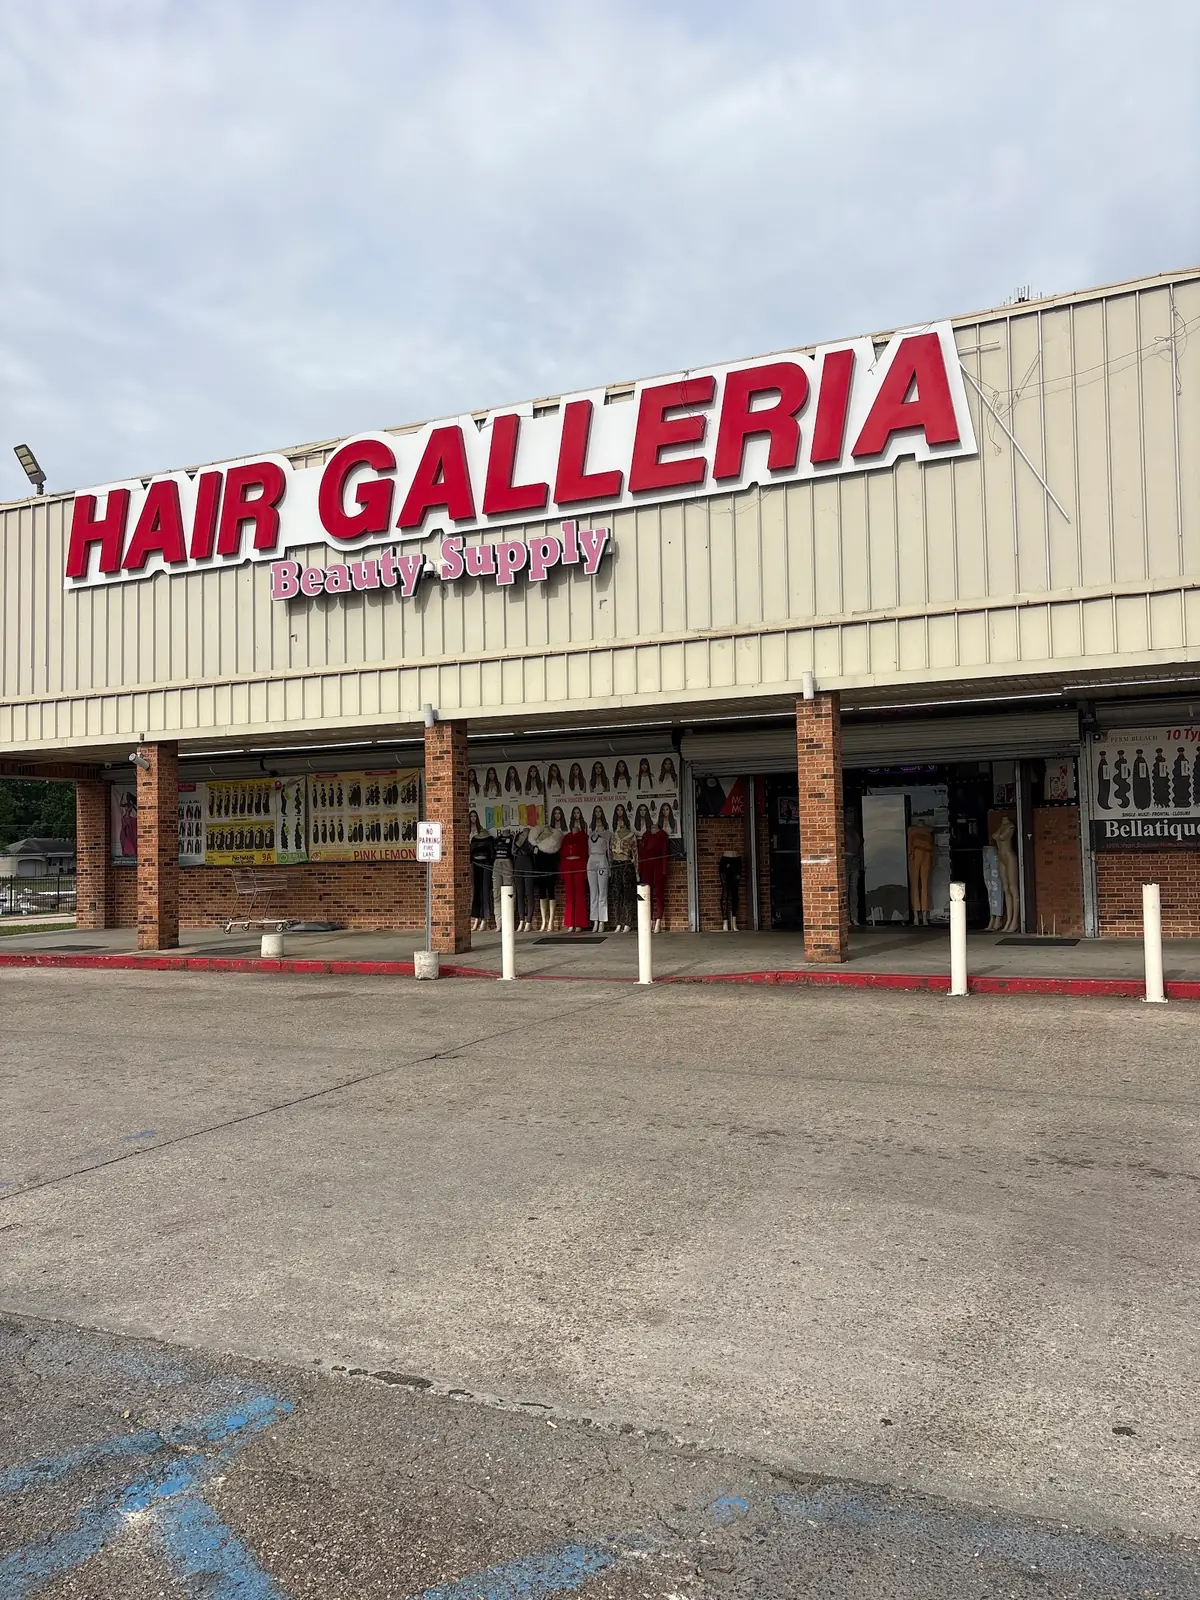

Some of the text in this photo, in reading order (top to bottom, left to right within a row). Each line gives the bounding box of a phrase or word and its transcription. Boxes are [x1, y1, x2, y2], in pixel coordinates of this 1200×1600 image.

[66, 333, 959, 578] HAIR GALLERIA
[270, 519, 611, 600] Beauty Supply
[1166, 728, 1200, 742] 10 Ty
[353, 850, 377, 861] PINK
